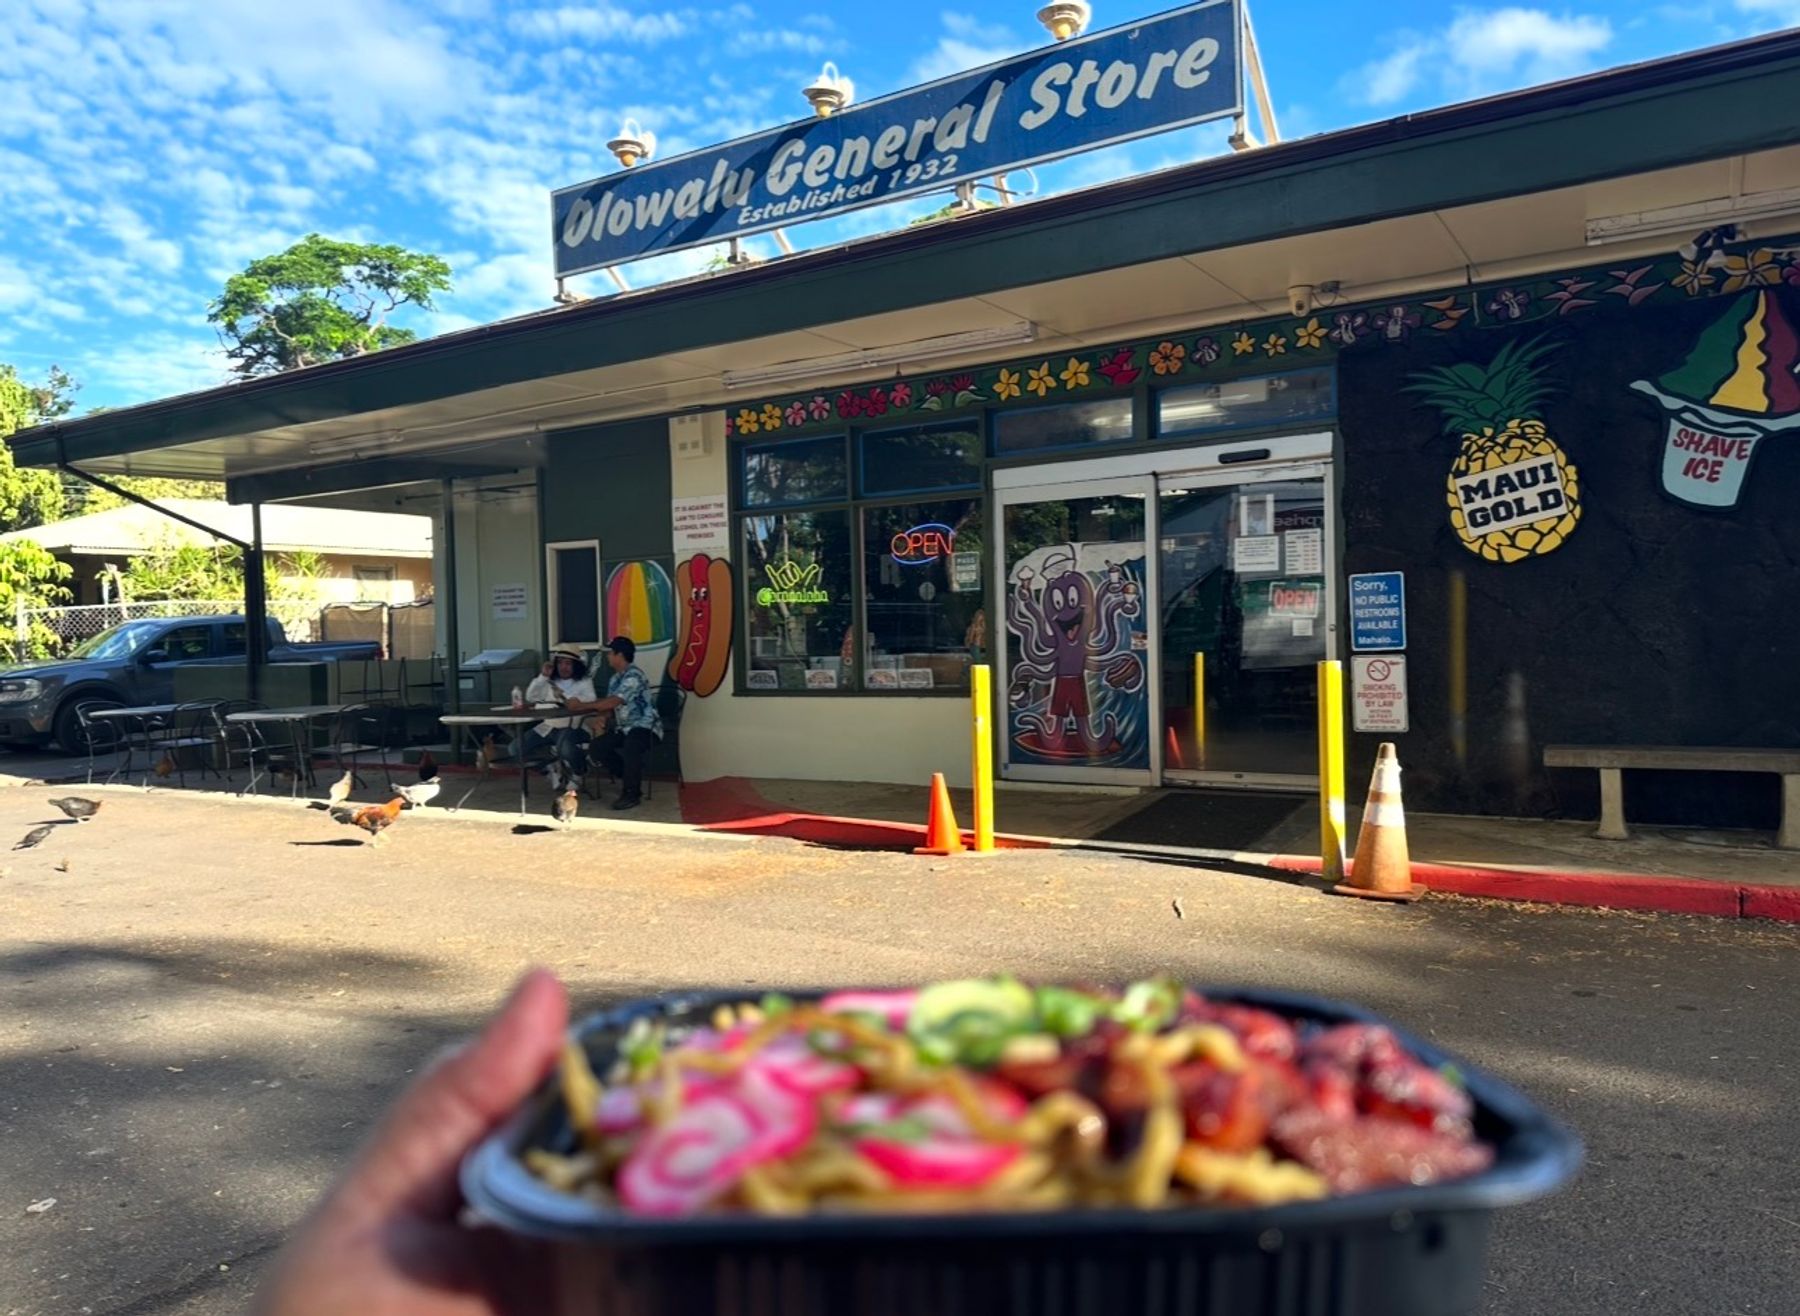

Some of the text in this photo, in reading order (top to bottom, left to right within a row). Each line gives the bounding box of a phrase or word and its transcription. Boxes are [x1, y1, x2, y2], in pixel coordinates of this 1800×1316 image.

[562, 37, 1220, 248] Olowalu General Store
[737, 153, 959, 225] Established 1932
[1672, 427, 1752, 461] SHAVE
[1682, 457, 1724, 483] ICE
[1459, 462, 1558, 505] MAUI
[1467, 488, 1563, 528] GOLD
[891, 532, 953, 556] OPEN
[1354, 580, 1388, 592] Sorry,
[1274, 589, 1316, 609] OPEN
[1355, 594, 1399, 606] NO PUBLIC
[1355, 607, 1400, 618] RESTROOMS
[1357, 619, 1399, 630] AVAILABLE
[1357, 692, 1403, 700] PROHIBITED
[1362, 683, 1397, 692] SMOKING
[1365, 700, 1394, 708] BY LAW
